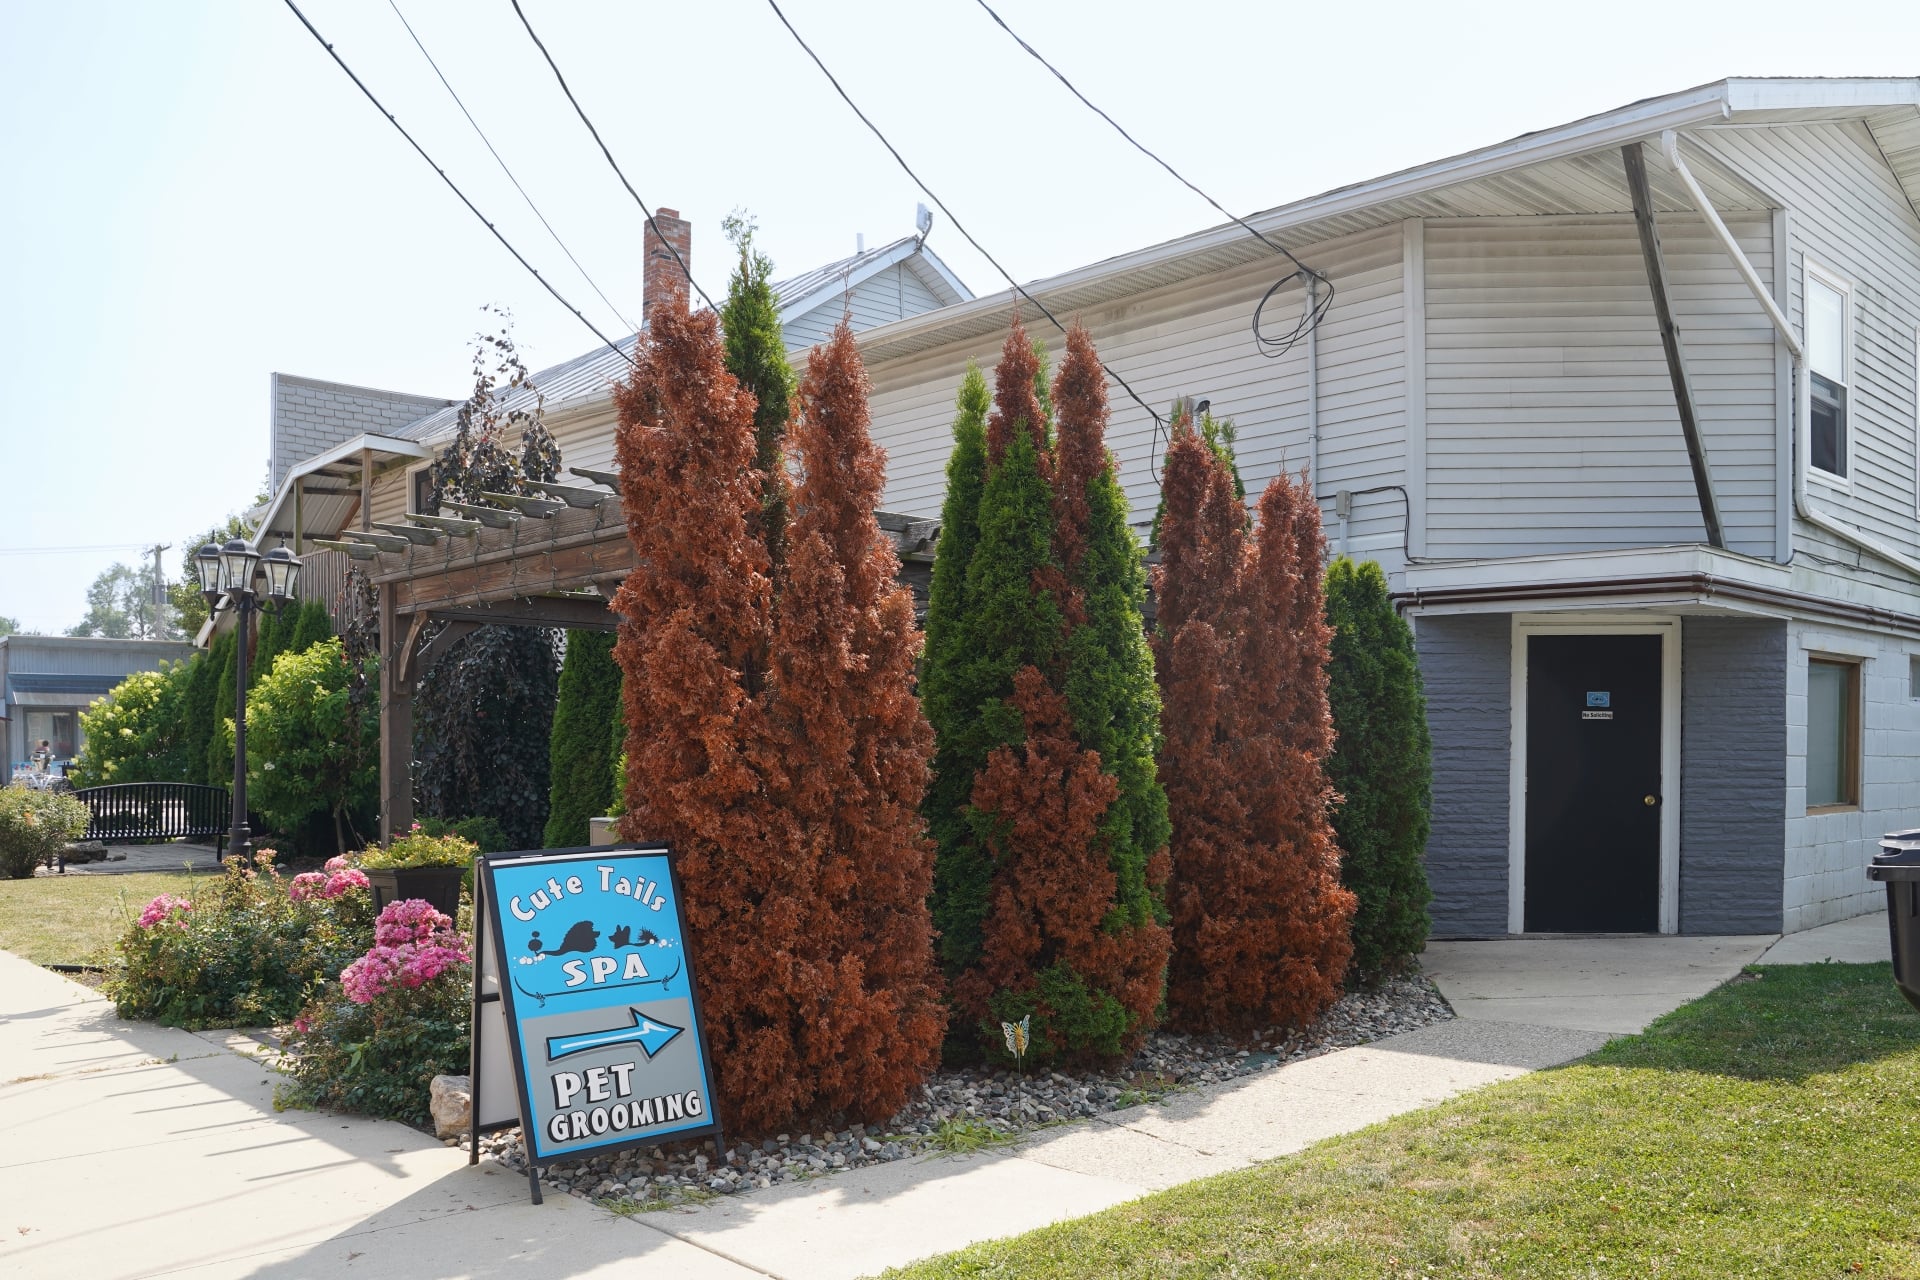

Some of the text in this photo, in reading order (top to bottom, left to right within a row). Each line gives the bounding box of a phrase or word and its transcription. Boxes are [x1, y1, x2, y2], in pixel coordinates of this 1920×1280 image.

[510, 866, 666, 922] Cute Tails
[562, 953, 649, 987] SPA
[552, 1062, 635, 1109] PET
[548, 1090, 702, 1143] GROOMING
